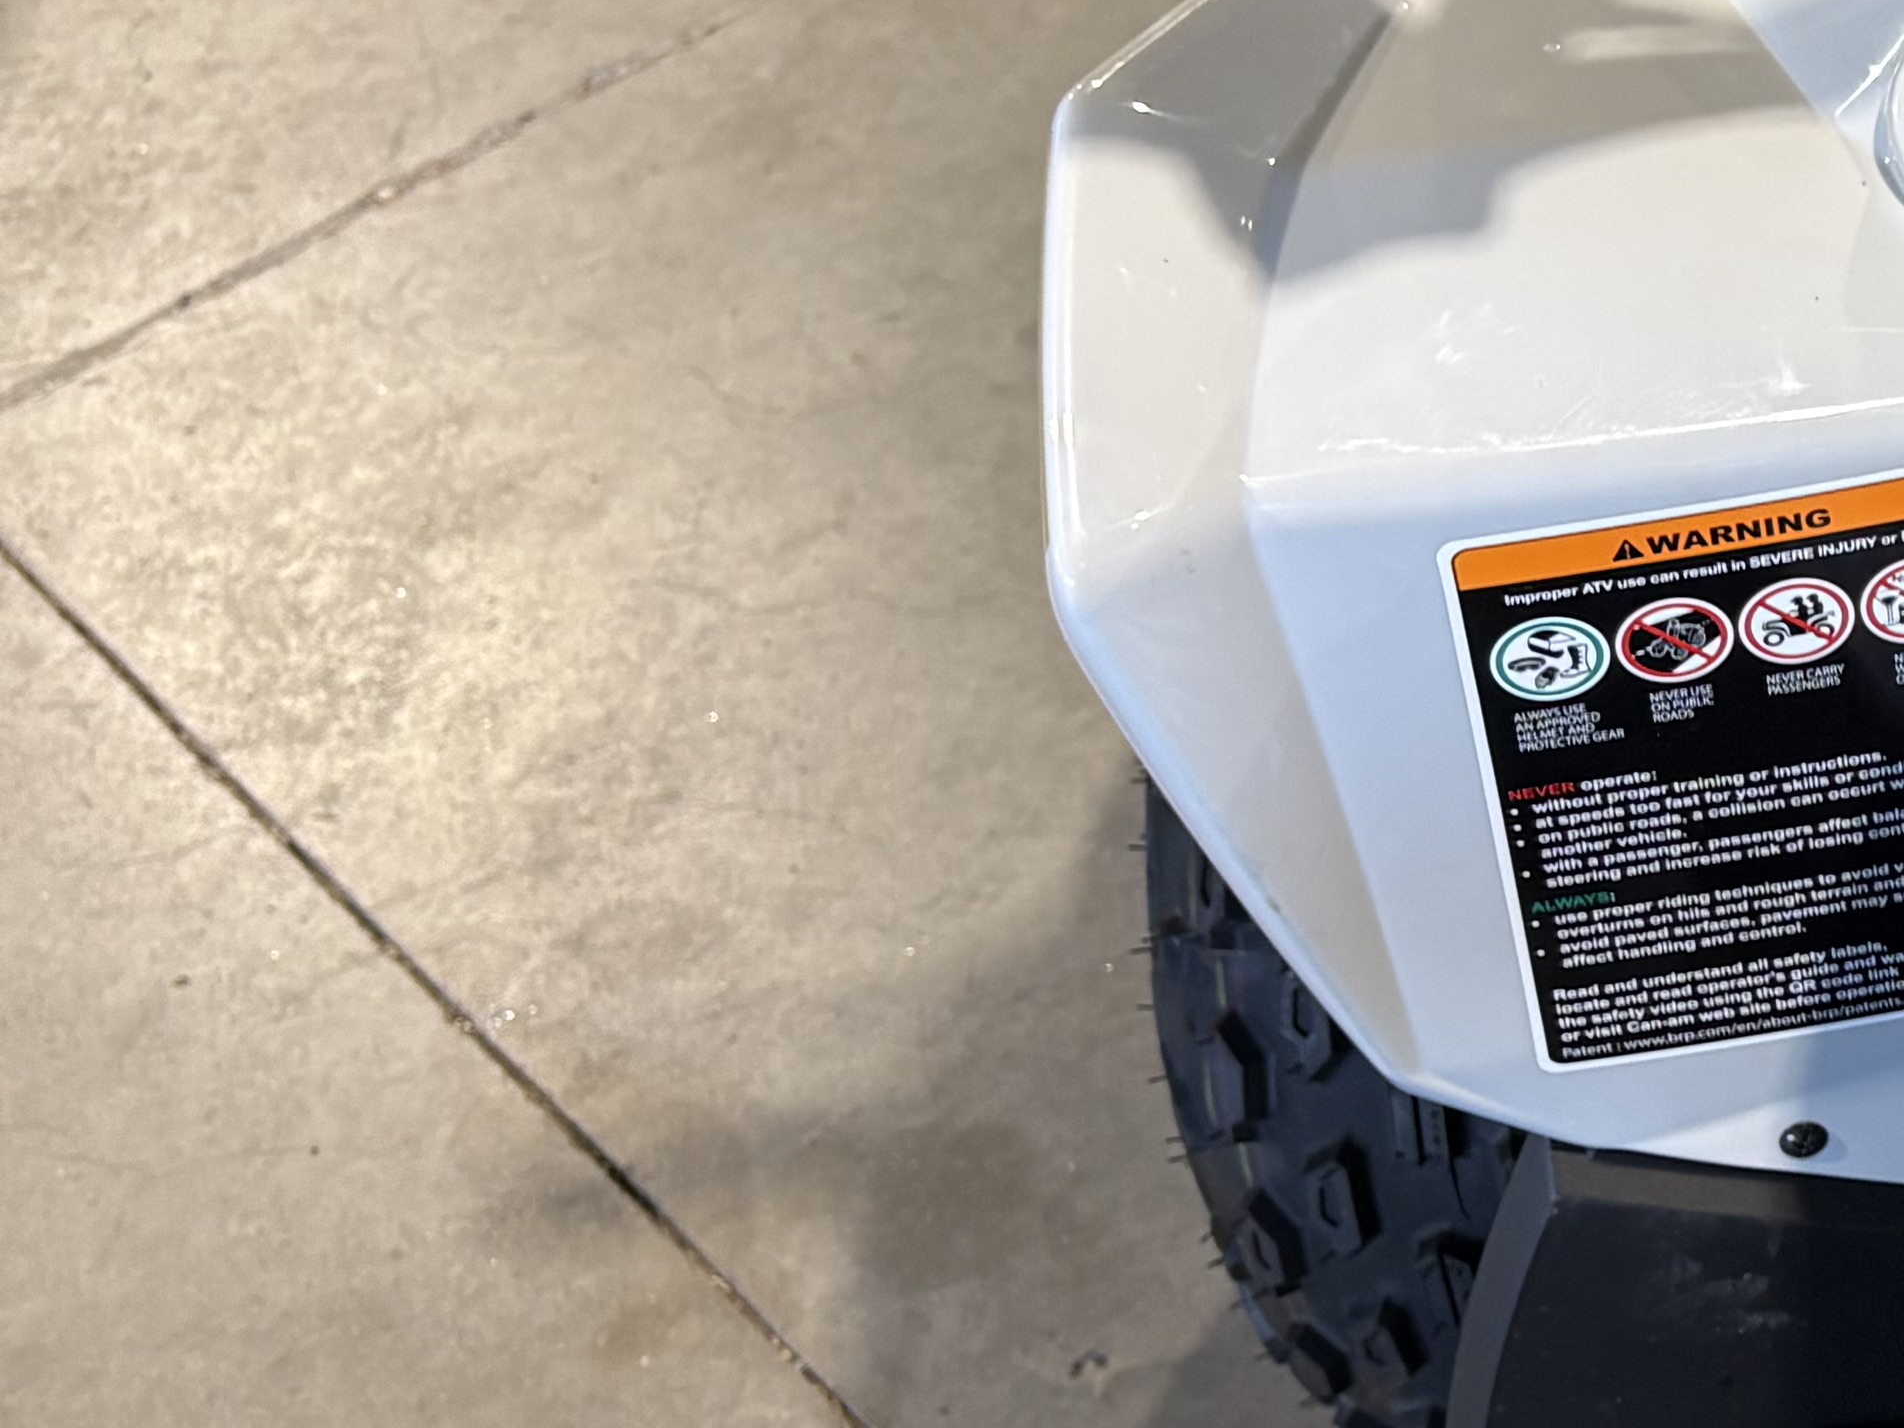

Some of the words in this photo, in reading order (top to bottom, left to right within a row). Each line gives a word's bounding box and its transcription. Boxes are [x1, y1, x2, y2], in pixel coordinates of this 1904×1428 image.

[1646, 507, 1831, 555] WARNING
[1503, 585, 1579, 607] Improper
[1581, 578, 1614, 595] ATV
[1617, 575, 1646, 590] use
[1649, 570, 1679, 585] can
[1682, 560, 1728, 580] result
[1730, 558, 1745, 571] in
[1749, 546, 1813, 569] SEVERE
[1817, 535, 1877, 557] INJURY
[1880, 533, 1898, 546] or
[1507, 781, 1575, 801] NEVER
[1579, 769, 1657, 792] operate:
[1530, 890, 1616, 914] ALWAYS:
